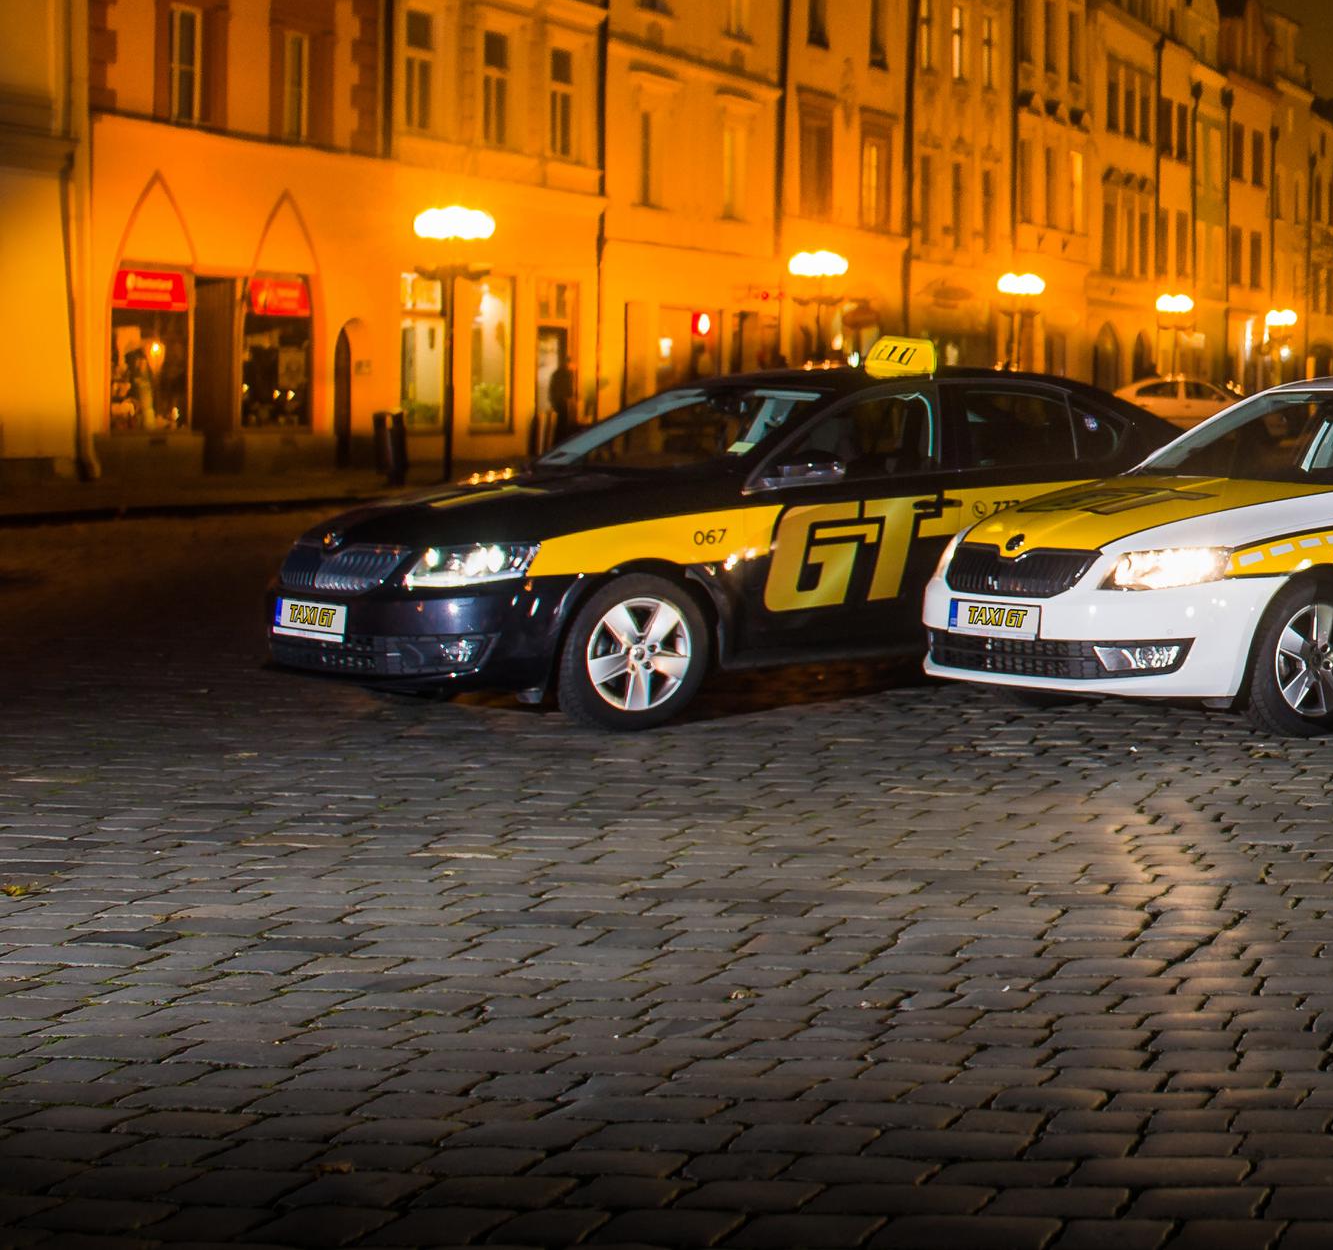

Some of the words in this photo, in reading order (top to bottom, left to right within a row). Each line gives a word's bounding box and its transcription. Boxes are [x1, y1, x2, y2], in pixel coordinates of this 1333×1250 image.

[693, 528, 728, 546] 067
[763, 494, 938, 613] GT
[290, 604, 319, 625] TAXI
[319, 607, 336, 627] GT
[968, 606, 1005, 626] TAXI
[1005, 609, 1028, 628] GT
